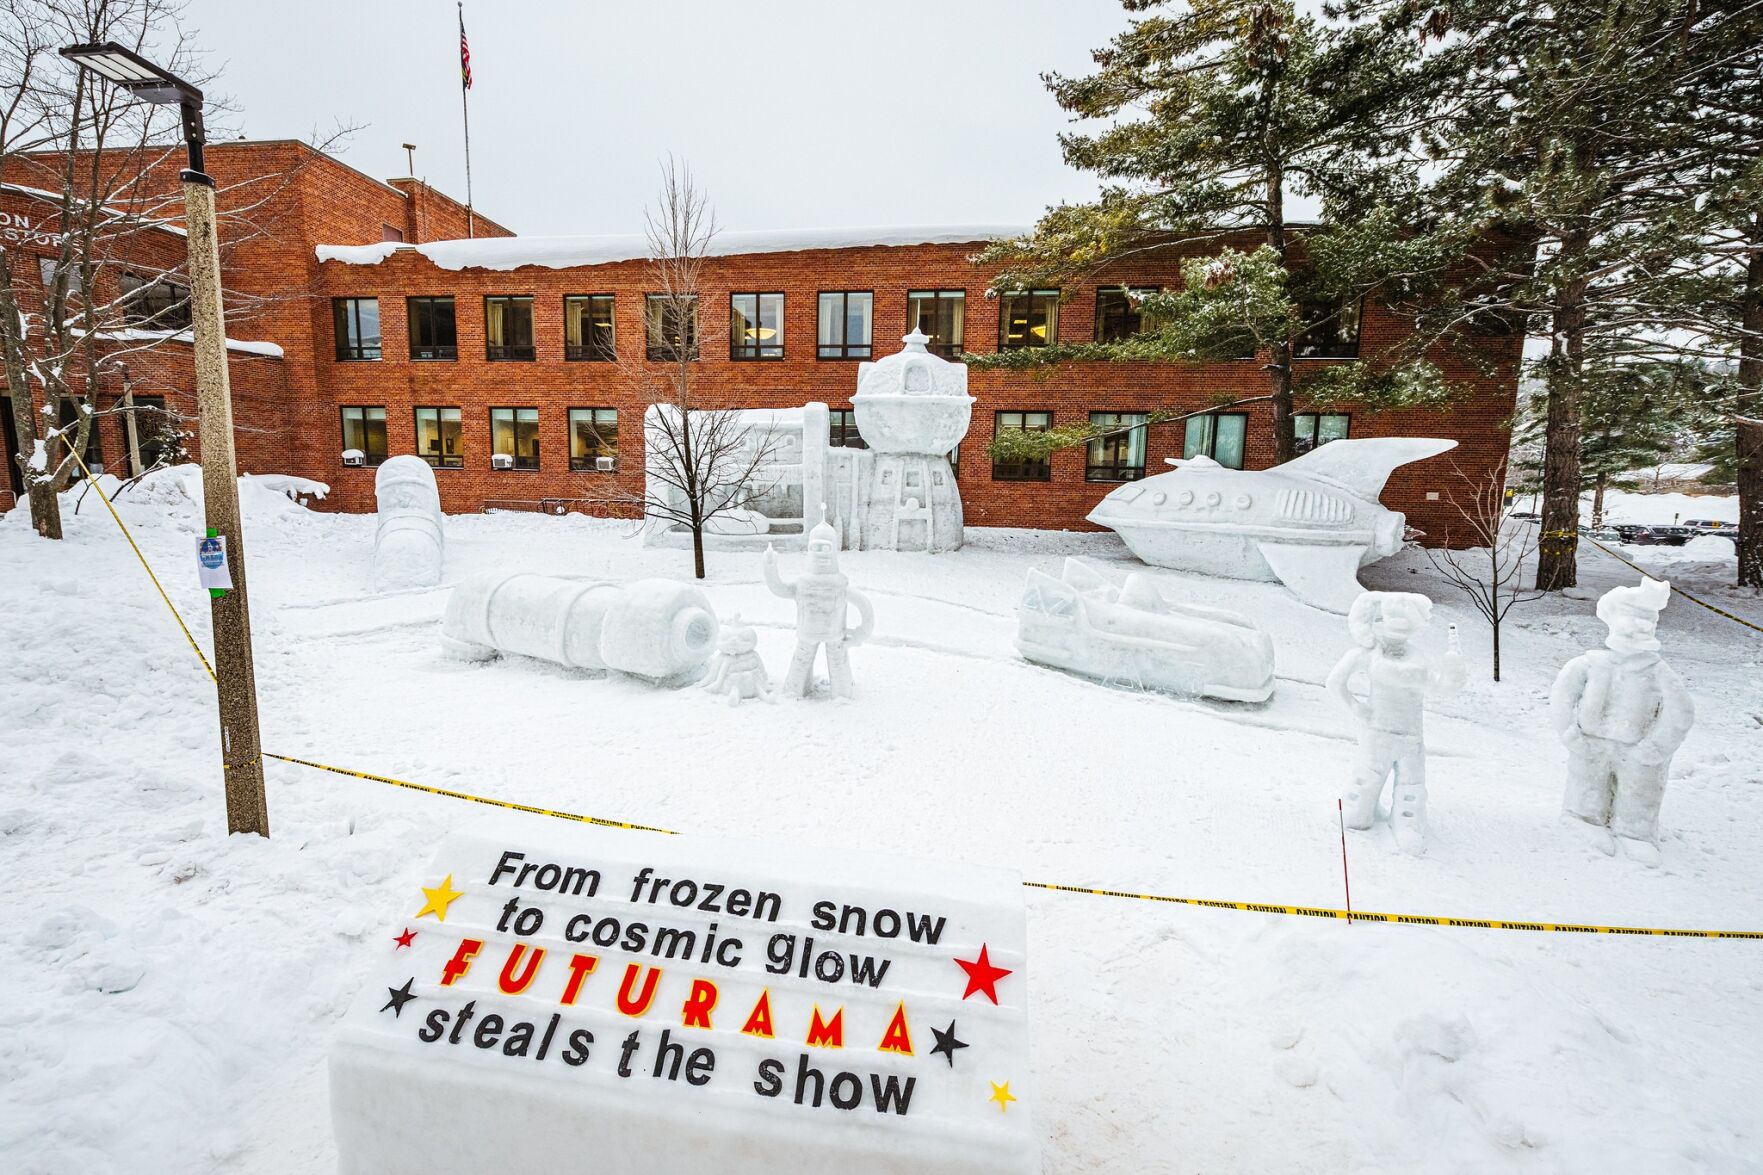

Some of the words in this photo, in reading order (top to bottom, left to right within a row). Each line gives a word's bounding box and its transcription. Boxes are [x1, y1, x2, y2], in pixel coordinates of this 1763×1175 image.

[488, 851, 600, 897] From
[631, 868, 781, 921] frozen
[811, 901, 946, 944] snow
[497, 897, 543, 936] to
[566, 914, 742, 967] cosmic
[766, 934, 891, 988] glow
[441, 938, 914, 1056] FUTURAMA
[419, 1000, 594, 1066] steals
[618, 1029, 715, 1086] the
[754, 1054, 916, 1115] show
